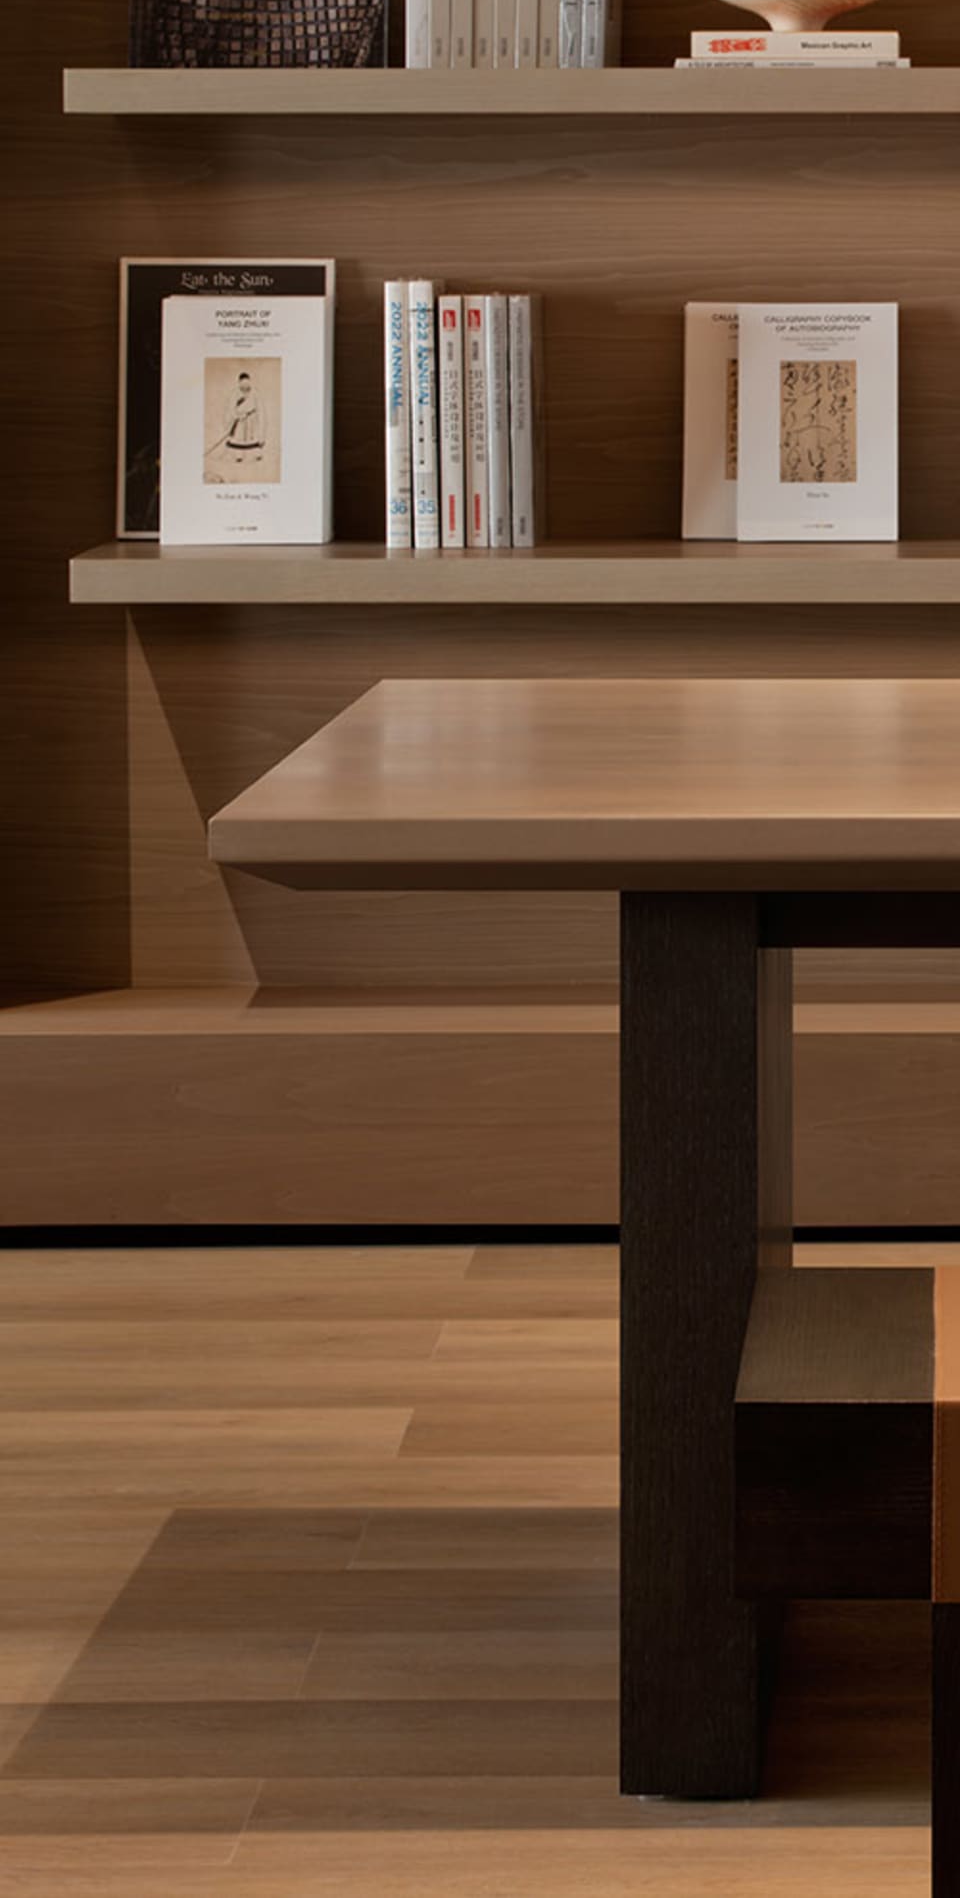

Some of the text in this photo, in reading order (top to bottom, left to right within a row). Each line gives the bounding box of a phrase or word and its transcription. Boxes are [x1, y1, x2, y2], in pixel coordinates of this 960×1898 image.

[213, 271, 236, 287] the
[215, 309, 271, 318] PORTRAIT OF
[763, 315, 872, 323] CALLIGRAPHY COPYBOOK
[218, 320, 241, 328] YANG
[416, 301, 429, 341] 2022
[789, 324, 861, 332] AUTOBIOGRAPHY
[391, 301, 403, 407] 2022 ANNUAL
[417, 499, 435, 515] 35
